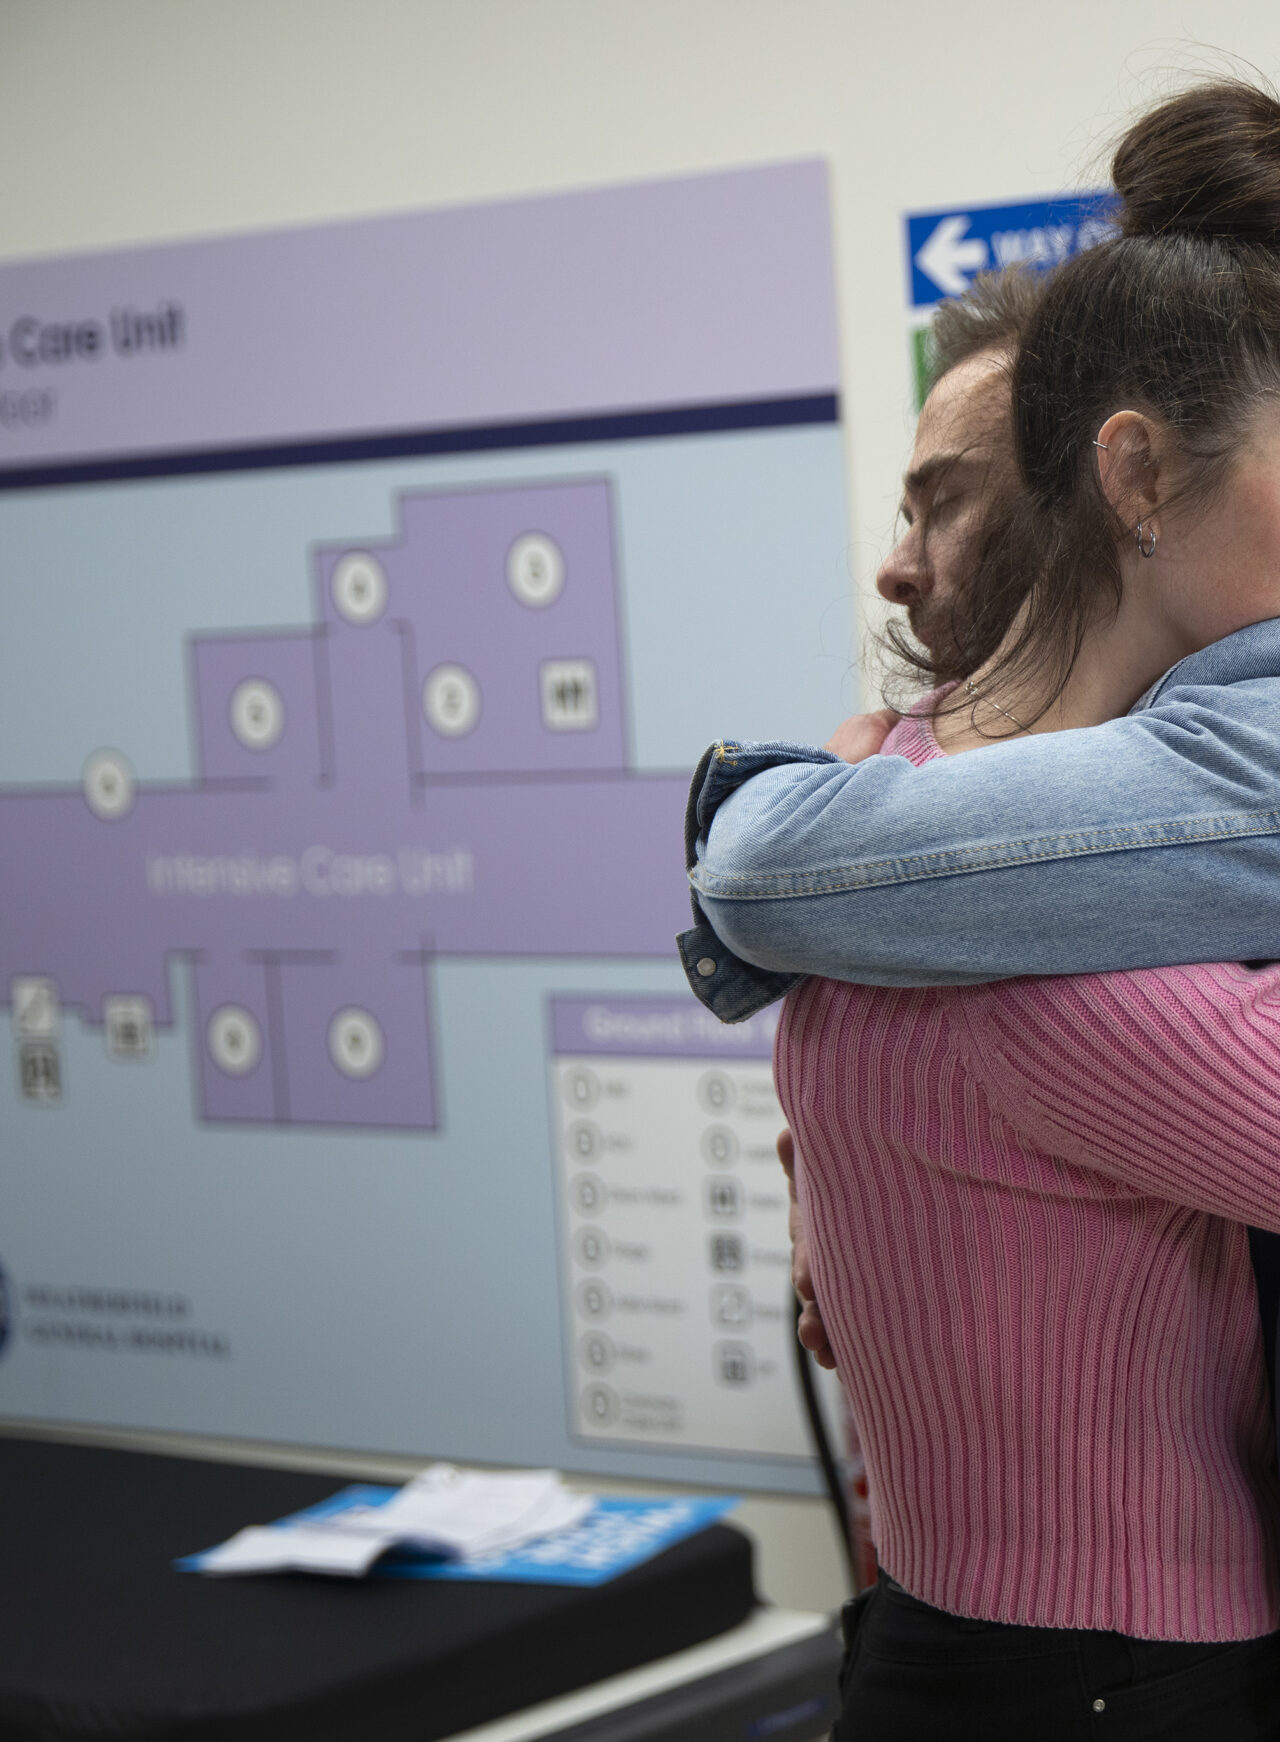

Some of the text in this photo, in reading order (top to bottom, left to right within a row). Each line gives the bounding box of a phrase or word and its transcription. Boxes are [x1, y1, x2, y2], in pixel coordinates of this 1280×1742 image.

[9, 315, 105, 369] Care
[109, 301, 186, 358] Unit
[147, 845, 474, 899] Intensive Care Unit
